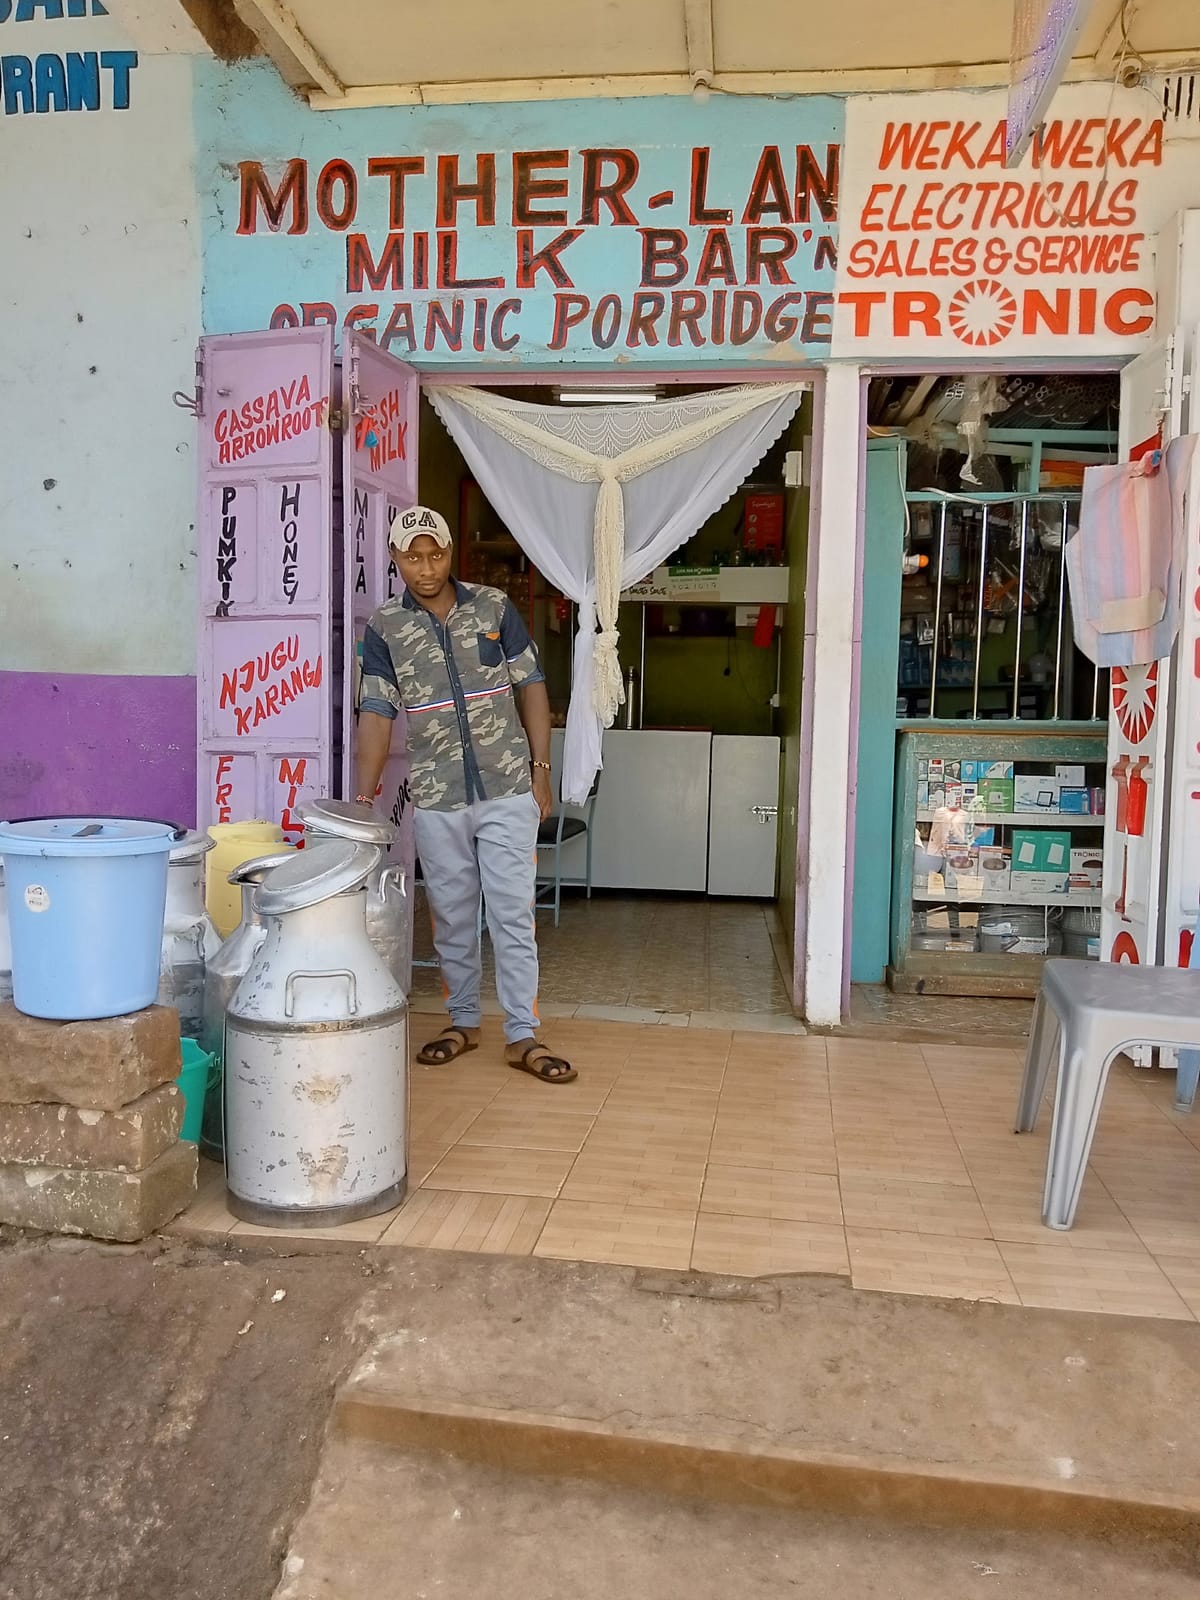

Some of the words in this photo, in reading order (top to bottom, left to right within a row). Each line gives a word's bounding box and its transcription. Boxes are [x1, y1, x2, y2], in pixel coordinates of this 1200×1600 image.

[0, 51, 138, 115] RANT
[878, 120, 1009, 170] WEKA
[1032, 118, 1164, 170] WEKA
[860, 180, 1139, 232] ELECTRICALS
[346, 228, 585, 293] MILK
[547, 289, 834, 350] PORRIDGE
[214, 374, 311, 443] CASSAVA
[369, 421, 408, 473] MILK
[281, 483, 301, 604] HONEY
[354, 487, 368, 594] MALA
[219, 634, 299, 710] NJUGU
[279, 758, 305, 849] MIL
